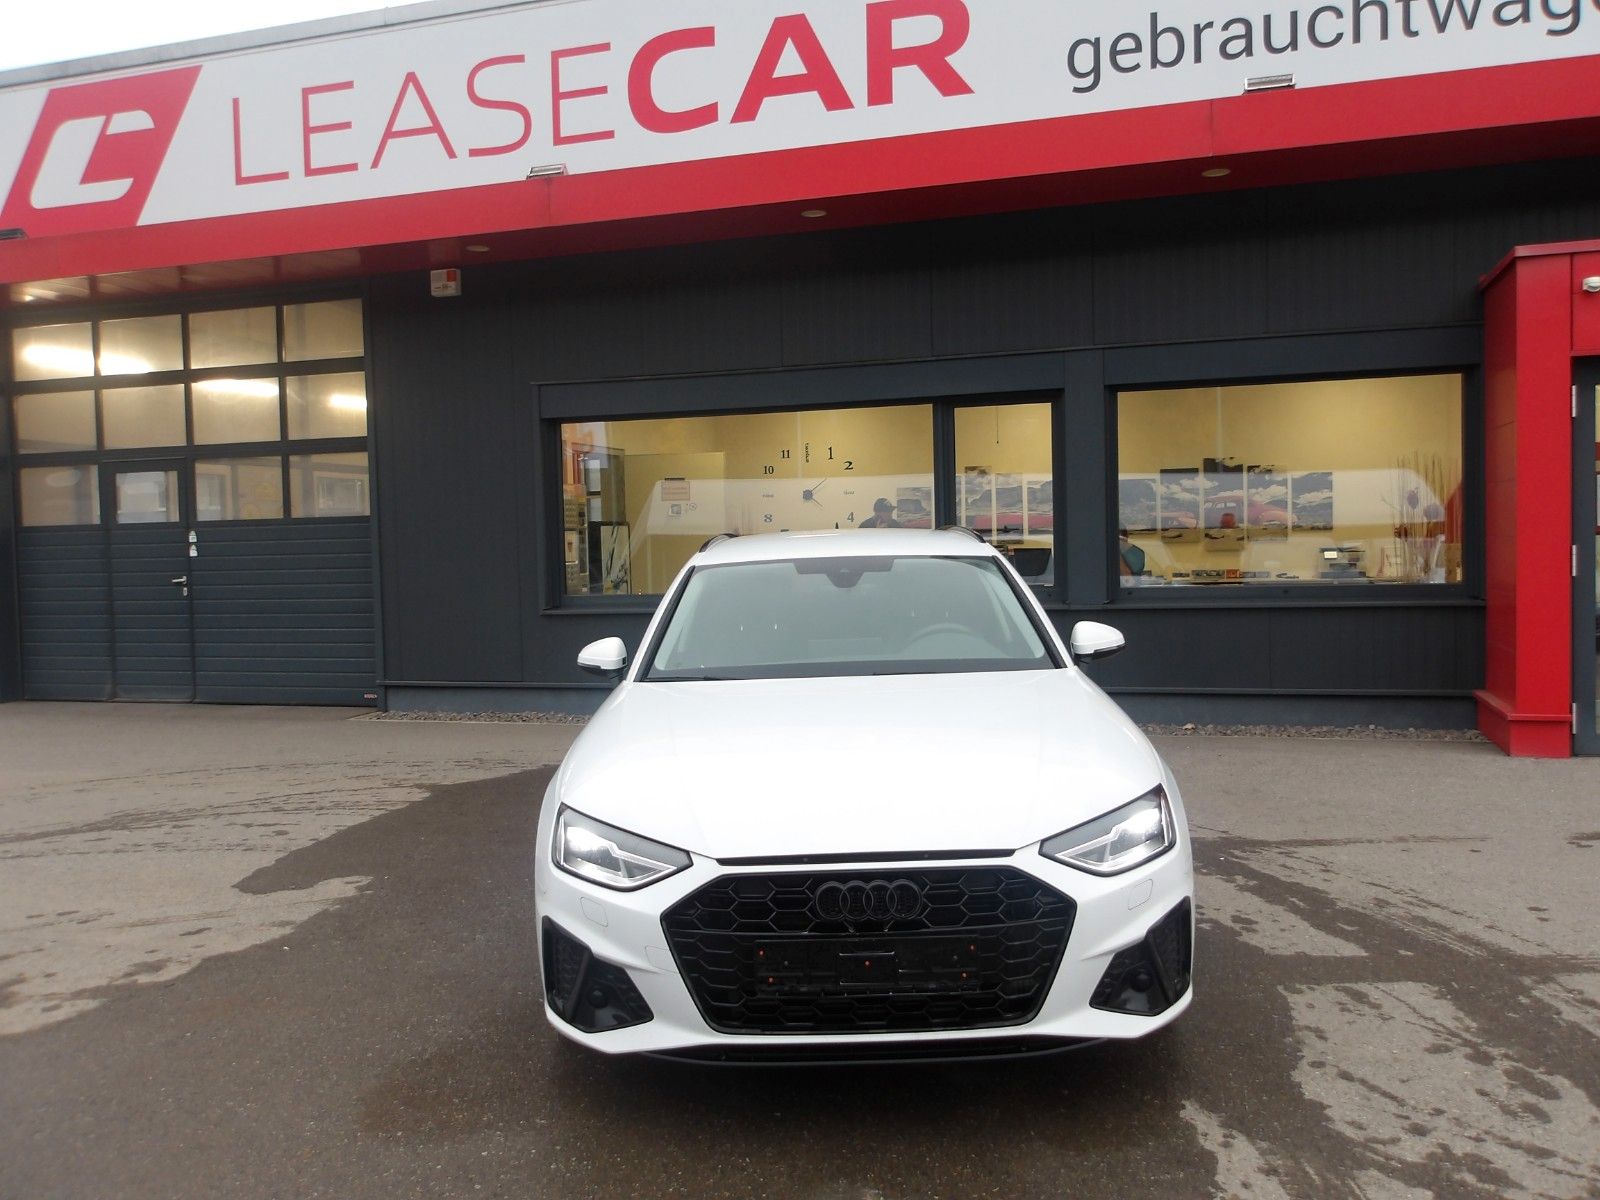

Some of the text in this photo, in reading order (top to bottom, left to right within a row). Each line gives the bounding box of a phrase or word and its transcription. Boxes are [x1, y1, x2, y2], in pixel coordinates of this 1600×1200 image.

[1066, 0, 1600, 94] gebrauchtwag
[231, 0, 976, 187] LEASECAR
[781, 449, 791, 459] 11
[828, 446, 834, 460] 1
[763, 465, 775, 475] 10
[844, 460, 854, 470] 2
[764, 513, 773, 523] 8
[847, 511, 855, 522] 4
